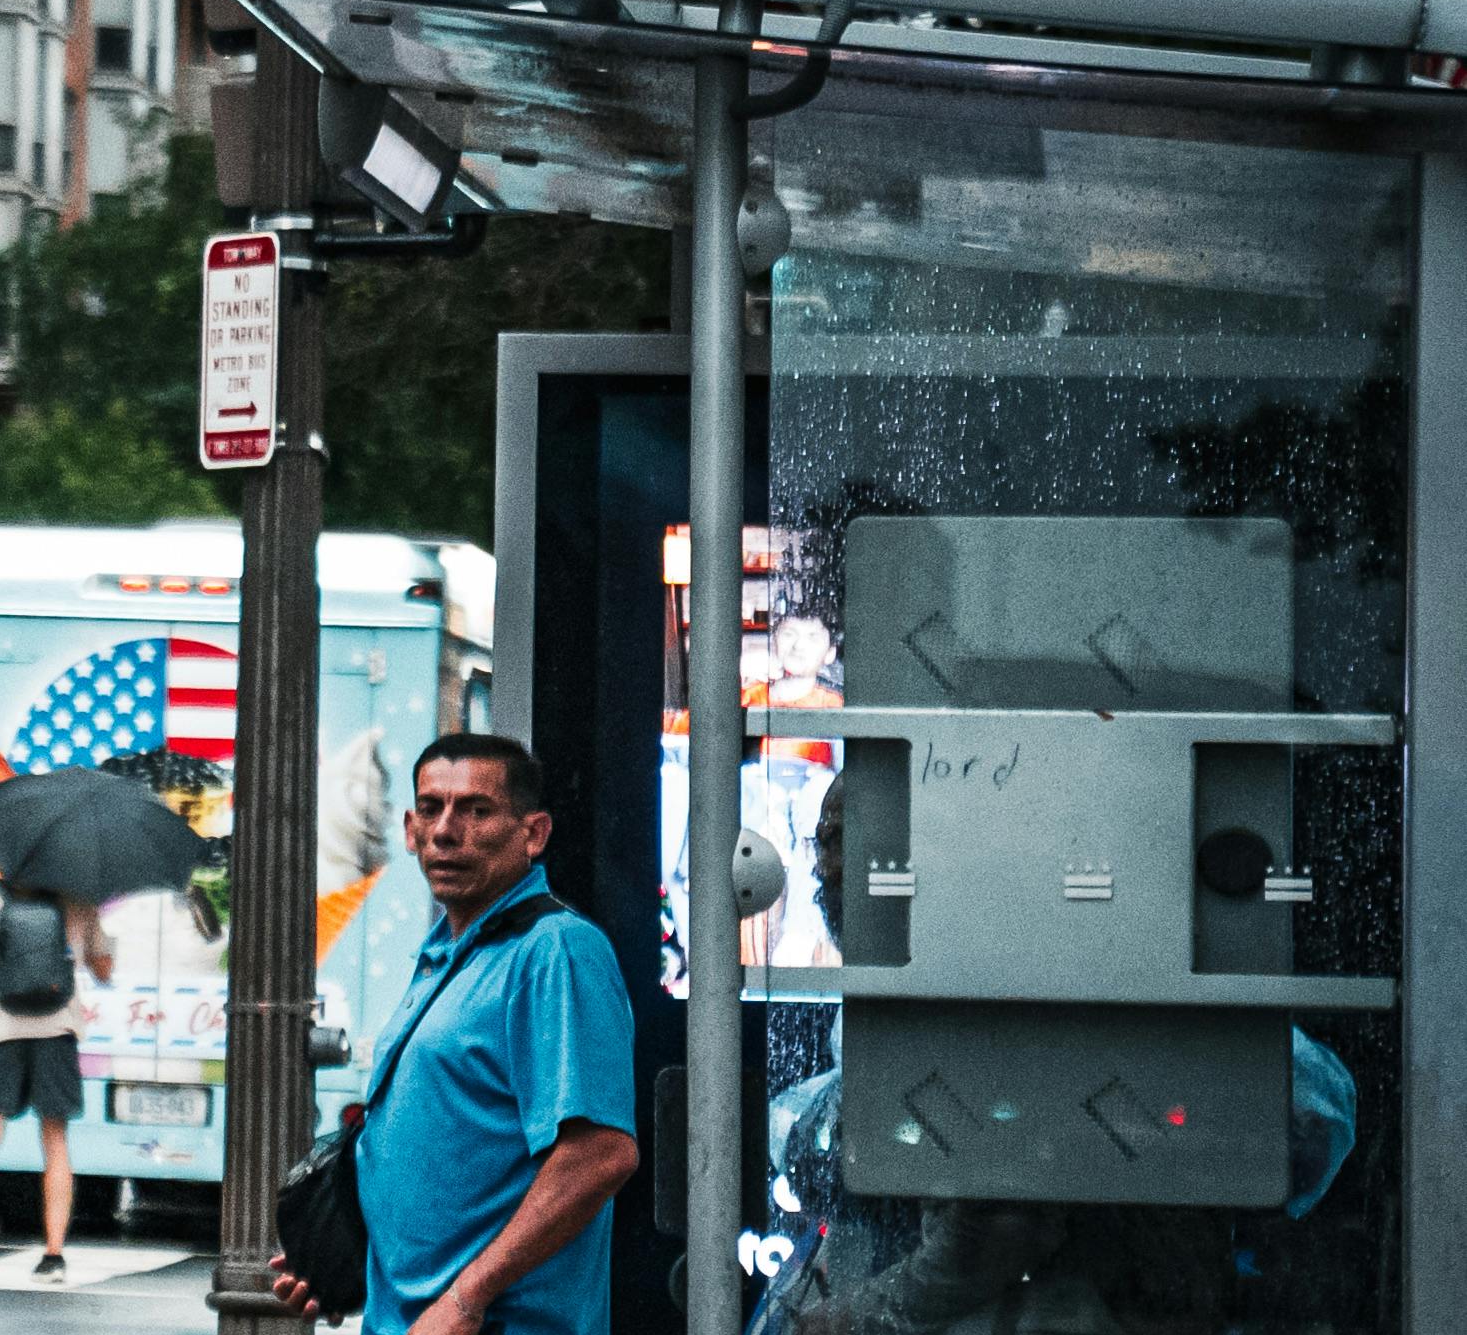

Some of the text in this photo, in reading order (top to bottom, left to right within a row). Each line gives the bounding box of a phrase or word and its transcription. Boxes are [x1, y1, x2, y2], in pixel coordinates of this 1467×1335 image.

[234, 273, 249, 294] NO
[212, 297, 270, 322] STANDING
[209, 324, 270, 348] OR PARKING
[213, 354, 267, 372] METRO BUS
